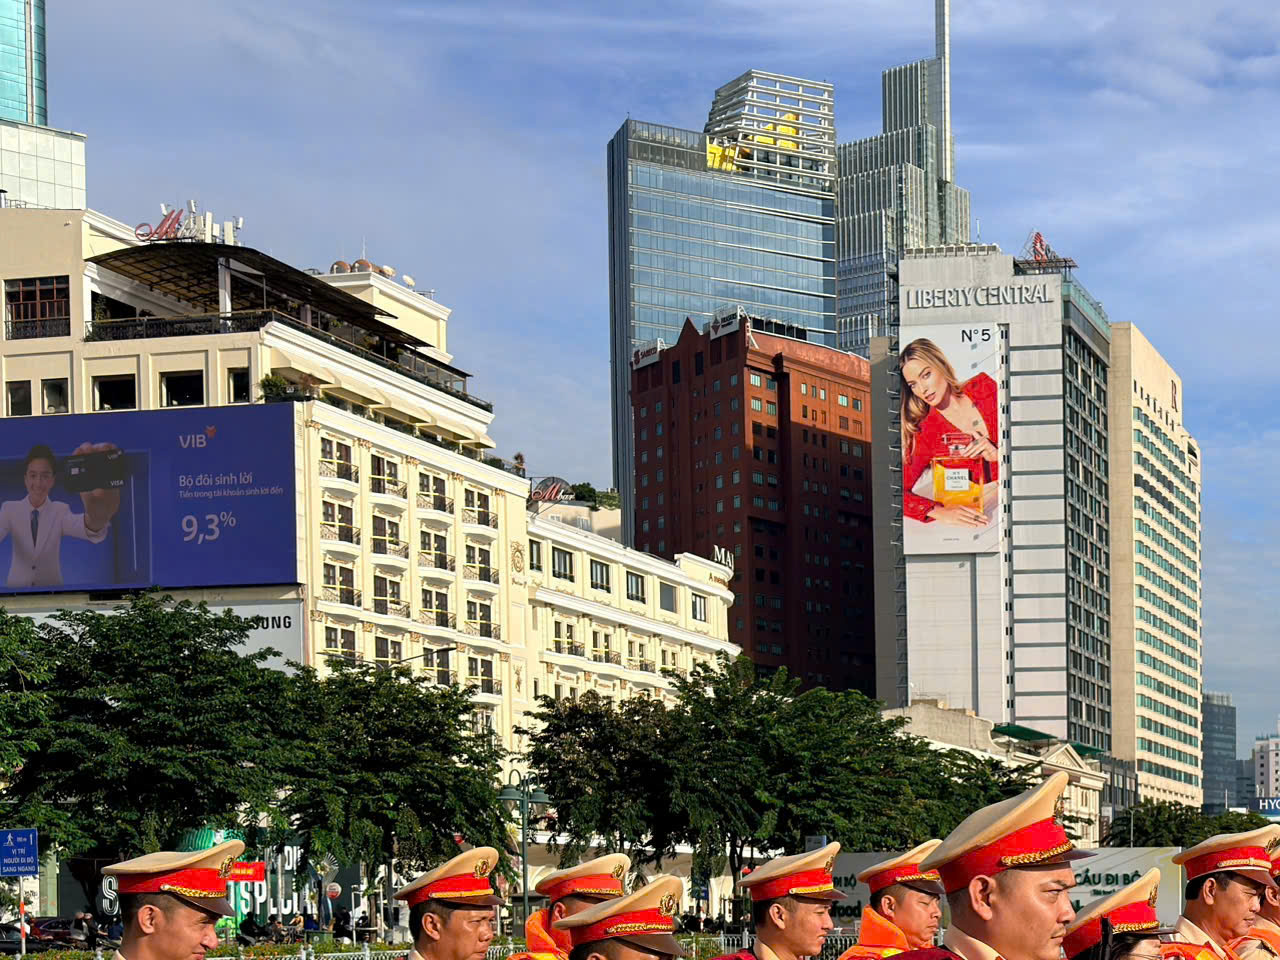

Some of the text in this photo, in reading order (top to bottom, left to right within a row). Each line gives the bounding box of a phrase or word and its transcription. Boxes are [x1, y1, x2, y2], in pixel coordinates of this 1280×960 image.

[907, 283, 1053, 309] LIBERTY CENTRAL
[179, 434, 207, 449] VIB
[179, 472, 253, 488] Bộ đôi sinh lời
[181, 511, 236, 545] 9,3%
[1074, 868, 1102, 886] CẦU
[1105, 873, 1119, 886] ĐI
